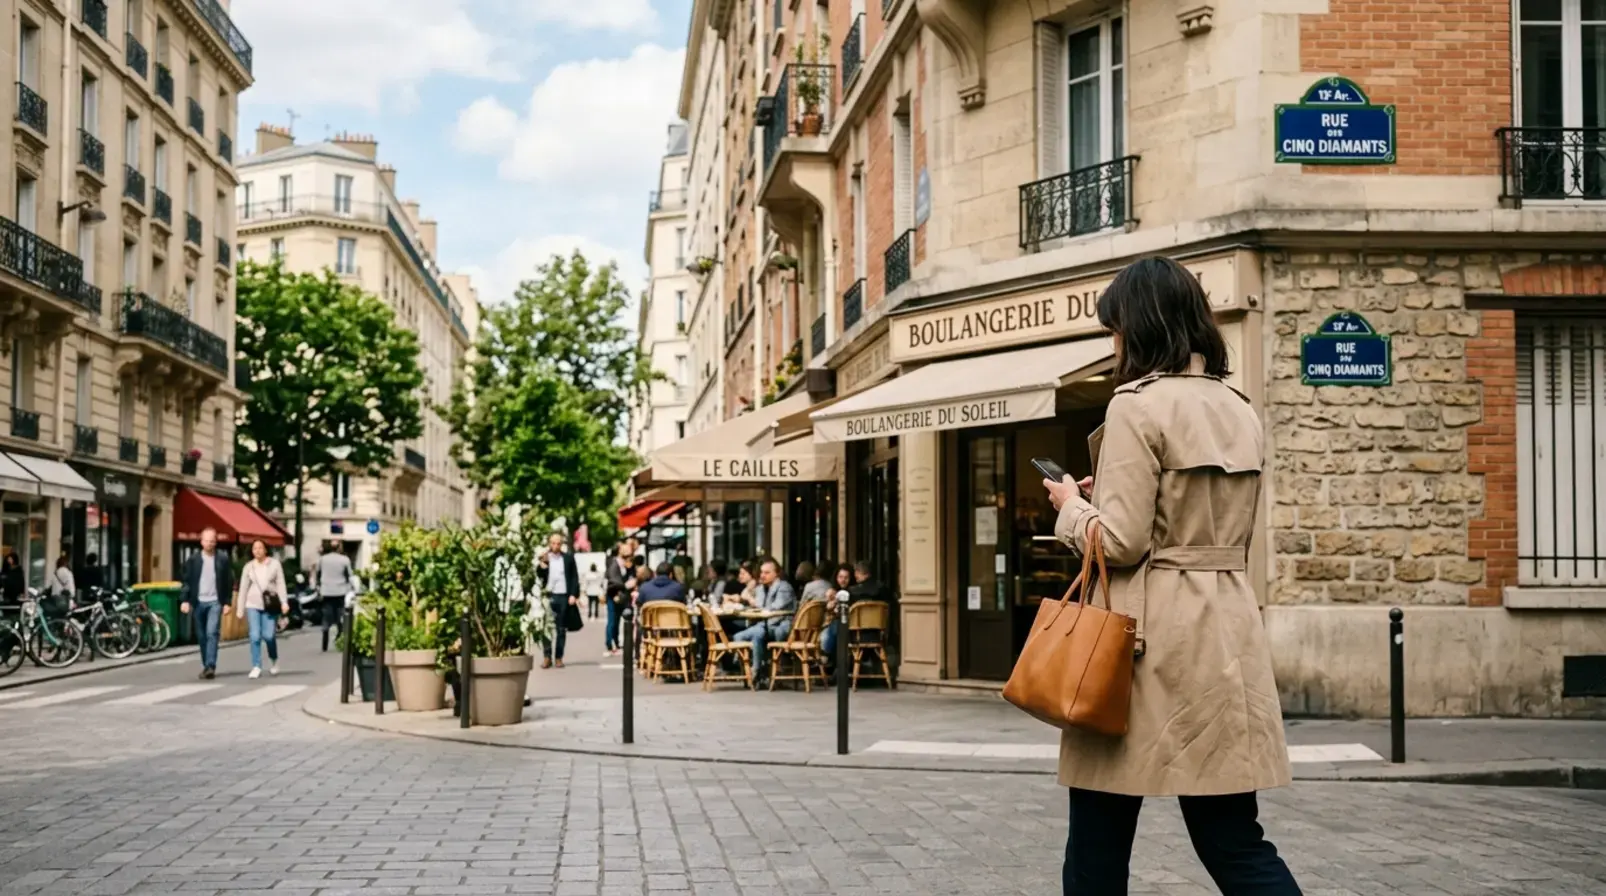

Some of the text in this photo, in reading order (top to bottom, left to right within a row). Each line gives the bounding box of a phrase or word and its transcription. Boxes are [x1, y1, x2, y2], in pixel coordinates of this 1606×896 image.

[1321, 113, 1348, 127] RUE
[1282, 139, 1388, 155] CINQ DIAMANTS
[908, 290, 1098, 348] BOULANGERIE DU
[1335, 342, 1356, 353] RUE
[1307, 363, 1385, 377] CINQ DIAMANTS
[846, 400, 1011, 436] BOULANGERIE DU SOLEIL
[703, 459, 799, 477] LE CAILLES
